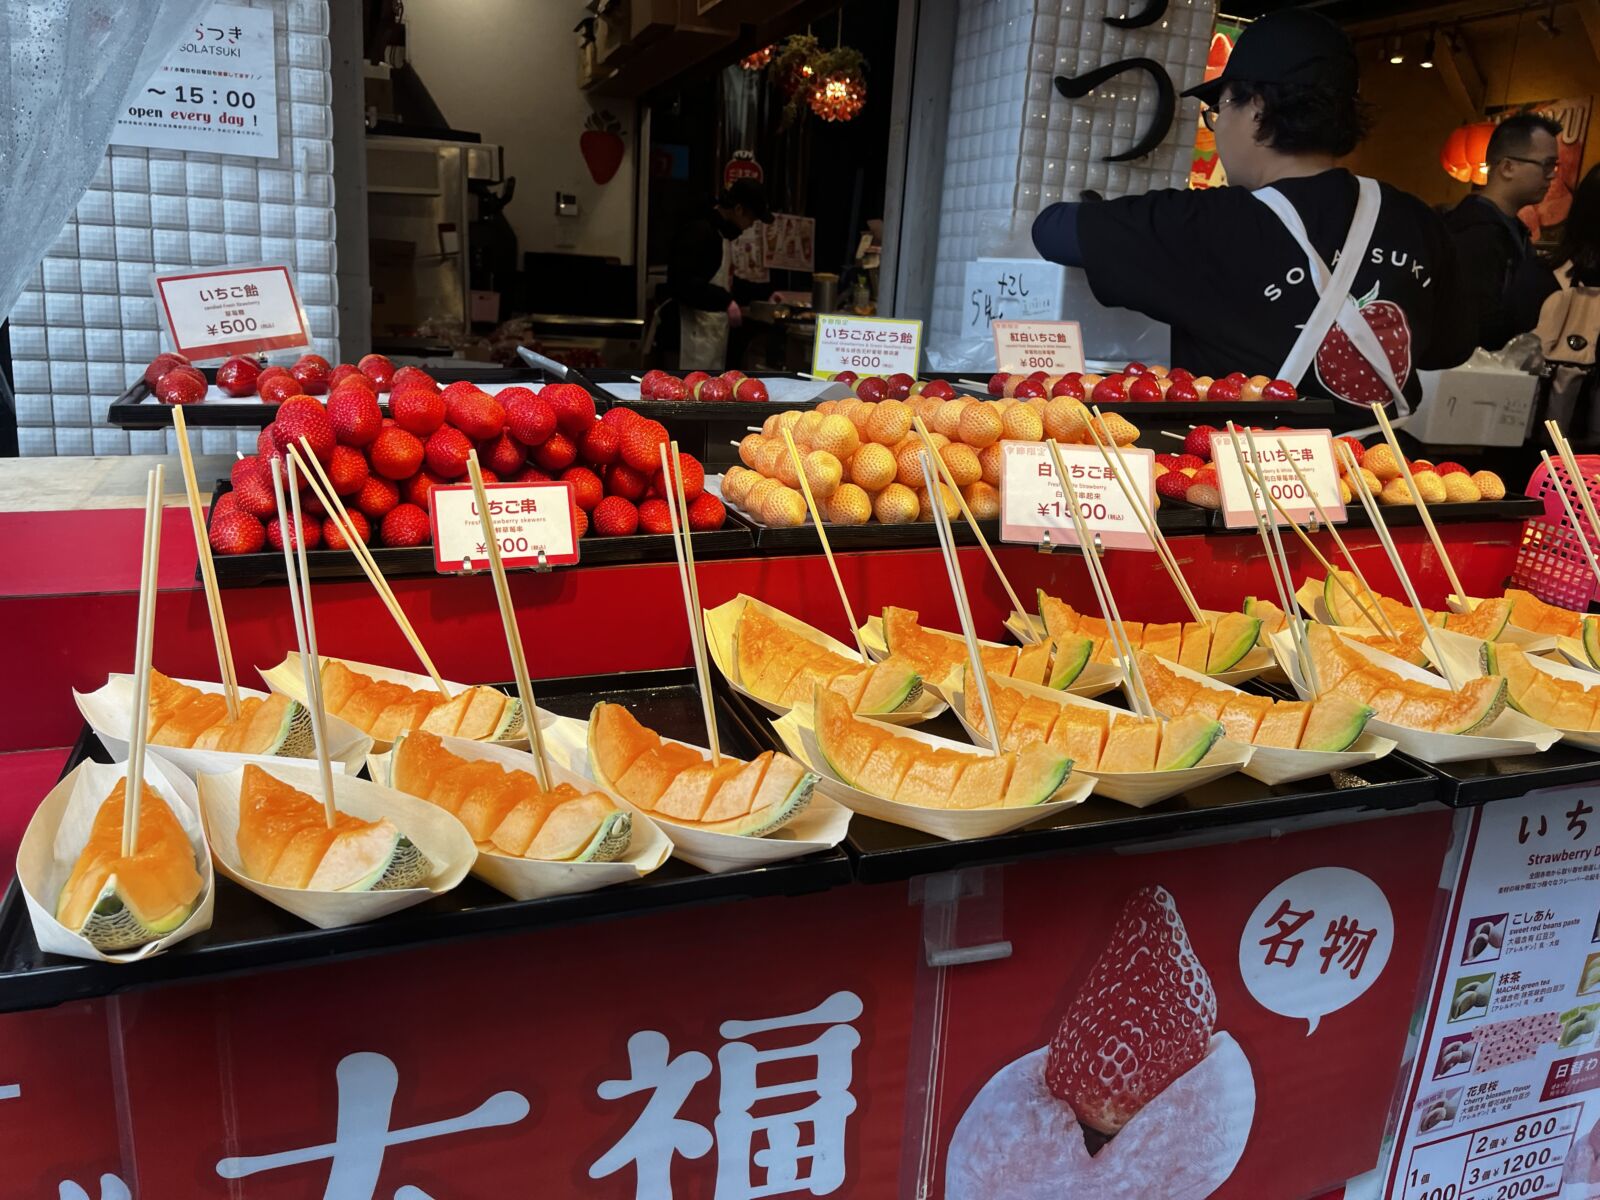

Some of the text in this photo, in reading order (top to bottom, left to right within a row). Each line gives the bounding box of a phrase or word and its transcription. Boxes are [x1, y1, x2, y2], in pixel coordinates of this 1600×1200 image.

[175, 85, 256, 110] 15:00
[128, 106, 163, 119] open
[170, 109, 212, 125] every
[219, 112, 244, 127] day
[200, 283, 260, 302] いちご飴
[206, 317, 257, 336] ¥500
[840, 355, 880, 368] ¥600
[1020, 357, 1054, 368] ¥800
[1518, 799, 1594, 845] いち
[1527, 848, 1592, 866] Strawberry
[1512, 908, 1555, 926] こしあん
[1509, 918, 1581, 935] sweet red beans paste
[1259, 898, 1378, 980] 名物
[1498, 970, 1522, 987] 抹茶
[1495, 984, 1521, 995] MACHA
[1520, 981, 1540, 991] green
[1463, 1096, 1484, 1106] Cherry
[1485, 1089, 1512, 1101] blossom
[1466, 1080, 1500, 1098] 花見桜
